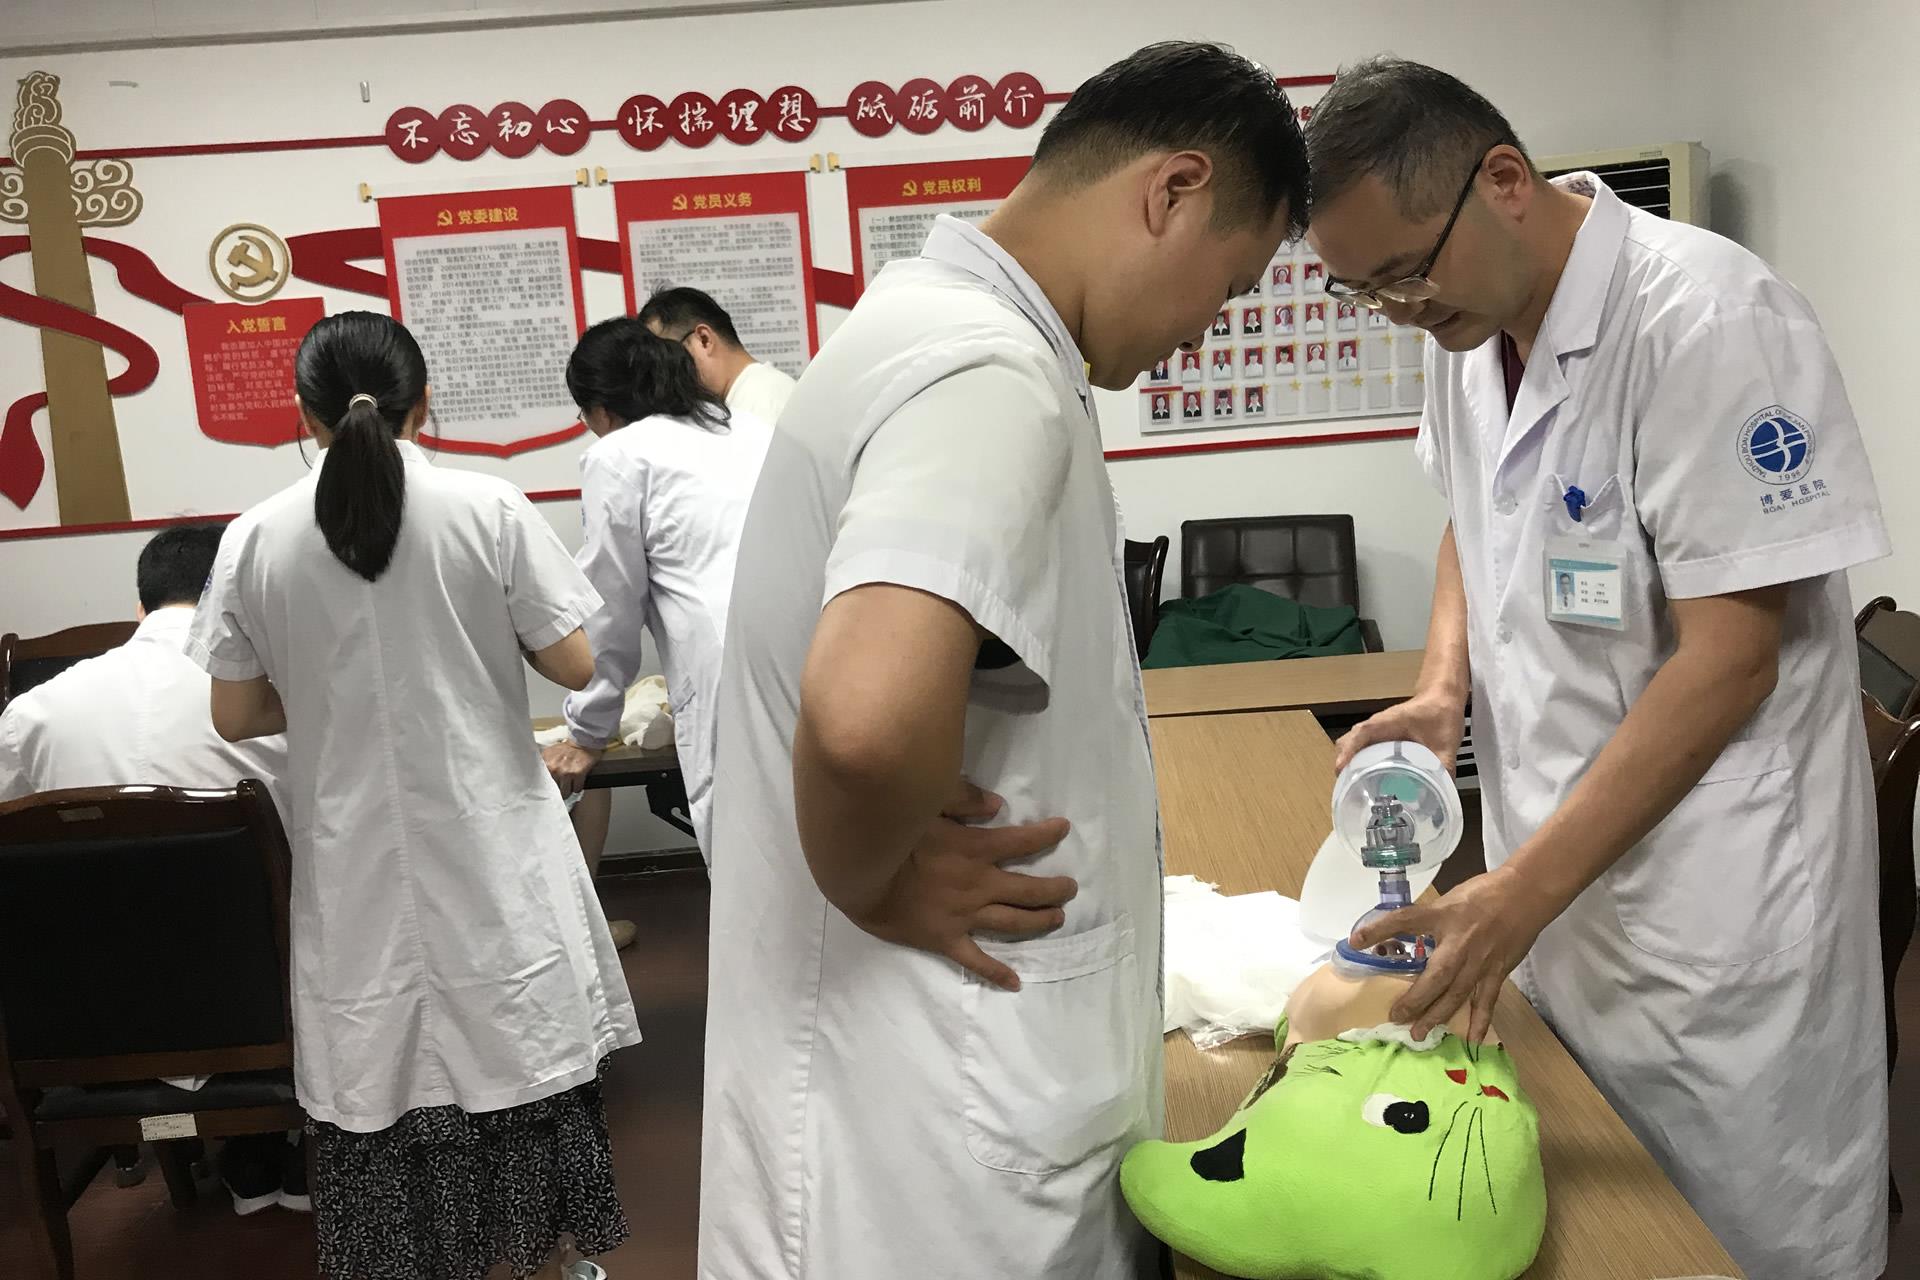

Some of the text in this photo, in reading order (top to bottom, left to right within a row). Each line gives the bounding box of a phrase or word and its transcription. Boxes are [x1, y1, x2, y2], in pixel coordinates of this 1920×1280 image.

[397, 83, 1035, 149] 不忘初心 怀揣理想 砥砺前行
[922, 177, 982, 196] 党员权利
[692, 192, 753, 210] 党员义务
[457, 207, 519, 225] 党委建设
[226, 316, 287, 333] 入党誓言
[1745, 411, 1773, 436] HOSPITAL
[1760, 479, 1827, 507] 博爱医院
[1763, 491, 1830, 514] BOAI HOSPITAL
